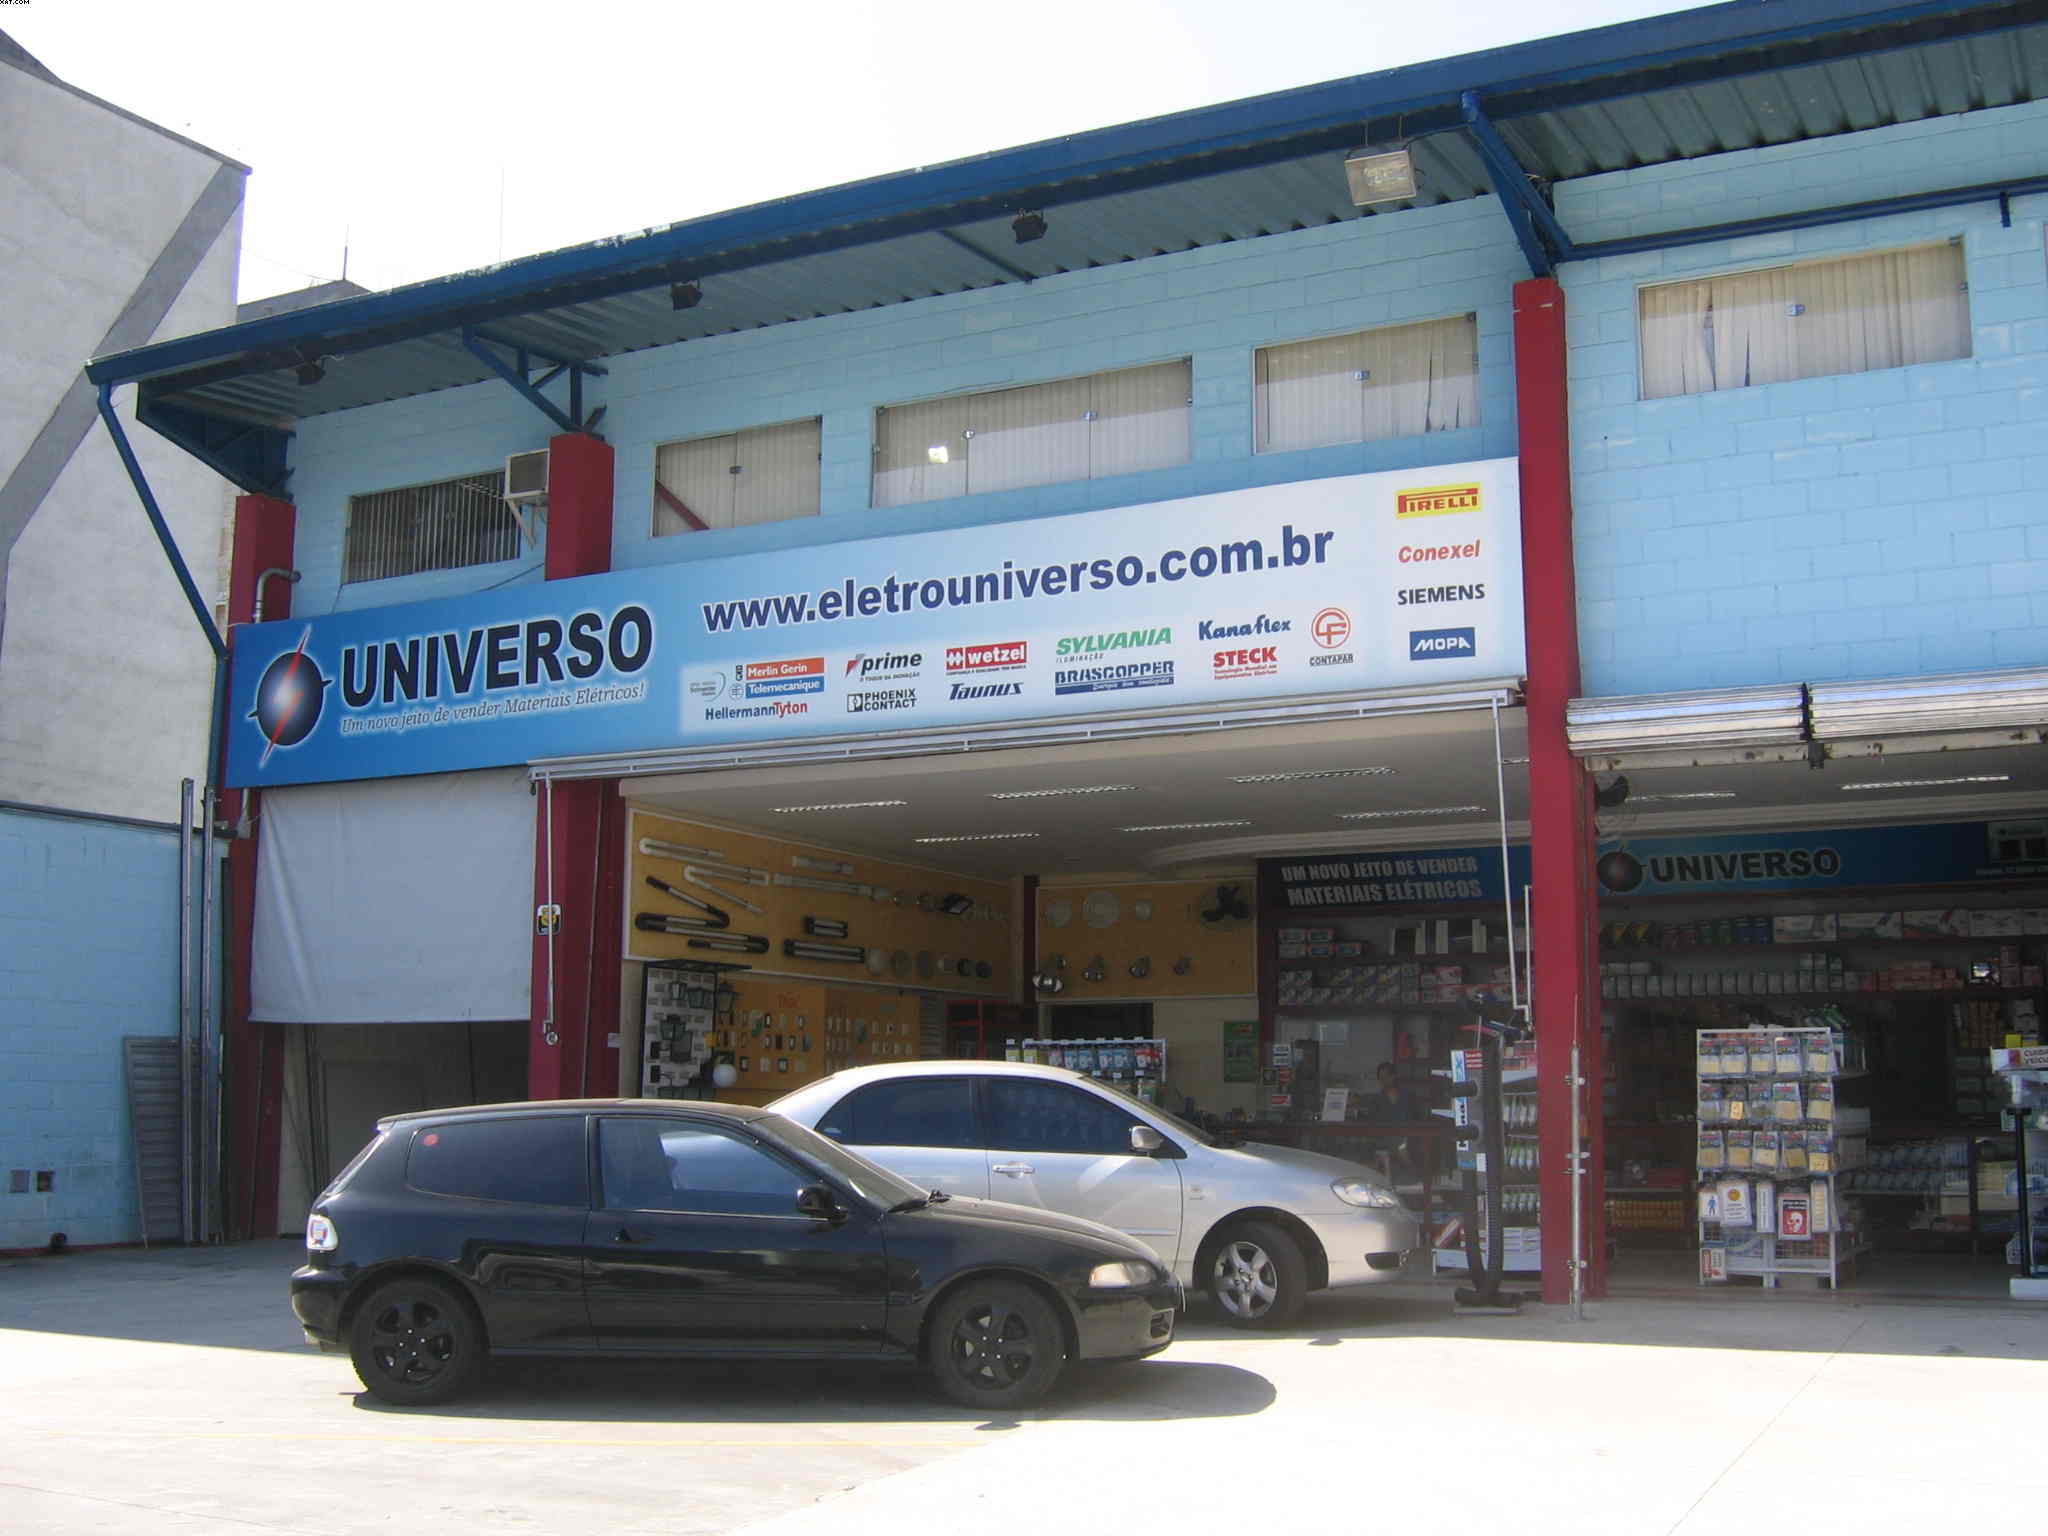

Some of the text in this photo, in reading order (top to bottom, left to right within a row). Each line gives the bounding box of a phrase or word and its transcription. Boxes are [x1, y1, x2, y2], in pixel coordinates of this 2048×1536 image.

[1398, 488, 1478, 513] PIRELLI
[1398, 540, 1480, 562] Conexel
[703, 525, 1334, 632] www.eletrouniverso.com.br
[1398, 584, 1485, 605] SIEMENS
[1199, 615, 1291, 640] Kanaflex
[1056, 627, 1172, 655] SYLVANIA
[1414, 637, 1470, 652] MOPA
[343, 606, 652, 707] UNIVERSO
[861, 652, 922, 676] prime
[968, 644, 1025, 664] wetzel
[1214, 646, 1276, 667] STECK
[748, 663, 808, 678] Merlin Gerin
[1055, 661, 1174, 683] BRASCOPPER
[750, 679, 820, 695] Telemecanique
[865, 688, 915, 701] PHOENIX
[949, 682, 1024, 700] Taunus
[342, 682, 646, 733] Um novo jeito de vender Materiais Elétricos!
[706, 702, 808, 720] HellermannTyton
[864, 698, 917, 711] CONTACT
[1281, 856, 1478, 882] UM NOVO JEITO DE VENDER
[1650, 848, 1839, 882] UNIVERSO
[1287, 883, 1384, 906] MATERIAIS
